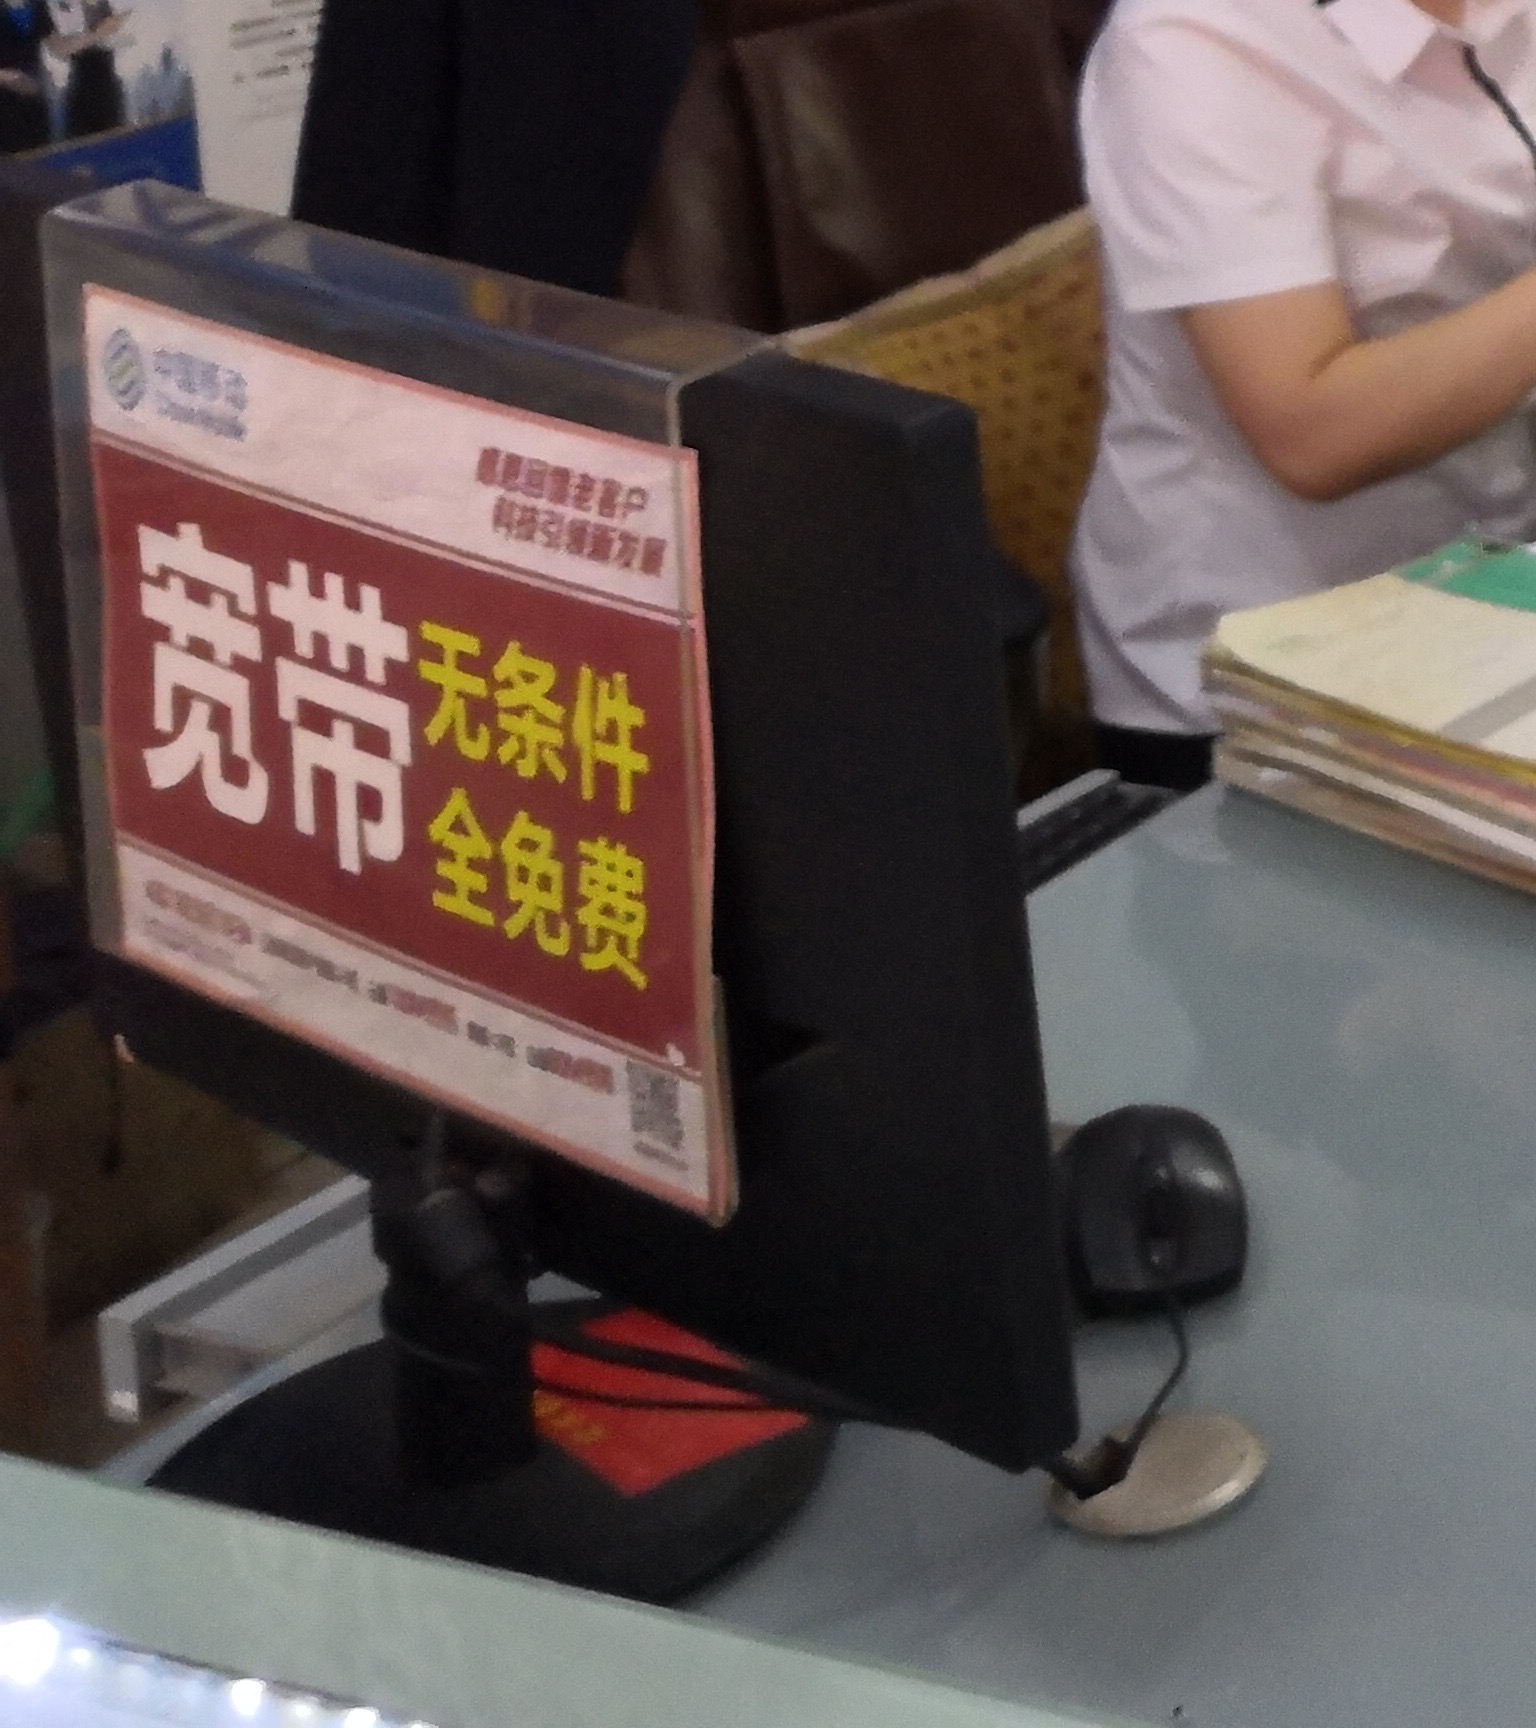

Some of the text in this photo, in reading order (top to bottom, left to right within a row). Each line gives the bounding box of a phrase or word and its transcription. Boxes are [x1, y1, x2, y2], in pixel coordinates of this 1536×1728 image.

[136, 521, 413, 875] 宽带
[416, 620, 650, 815] 无条件
[427, 786, 649, 991] 全免费
